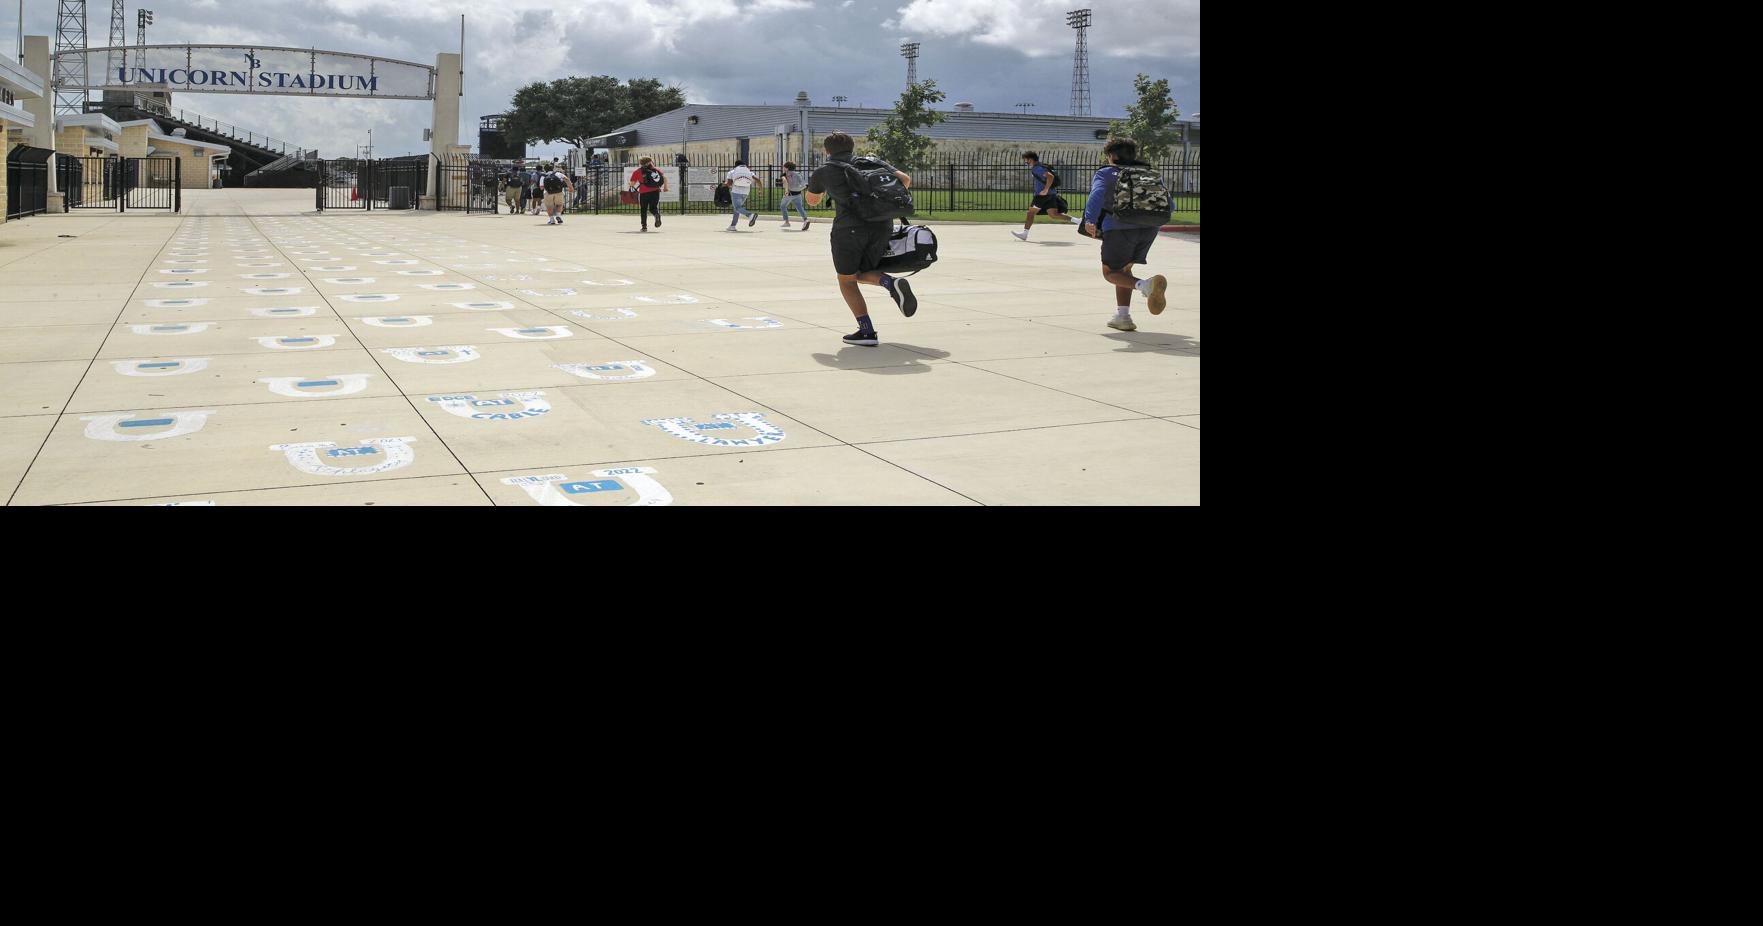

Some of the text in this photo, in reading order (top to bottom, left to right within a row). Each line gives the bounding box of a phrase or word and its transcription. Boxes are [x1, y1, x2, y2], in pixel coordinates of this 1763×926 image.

[119, 67, 379, 91] UNICORN STADIUM
[604, 467, 643, 477] 2022
[572, 482, 604, 492] AT
